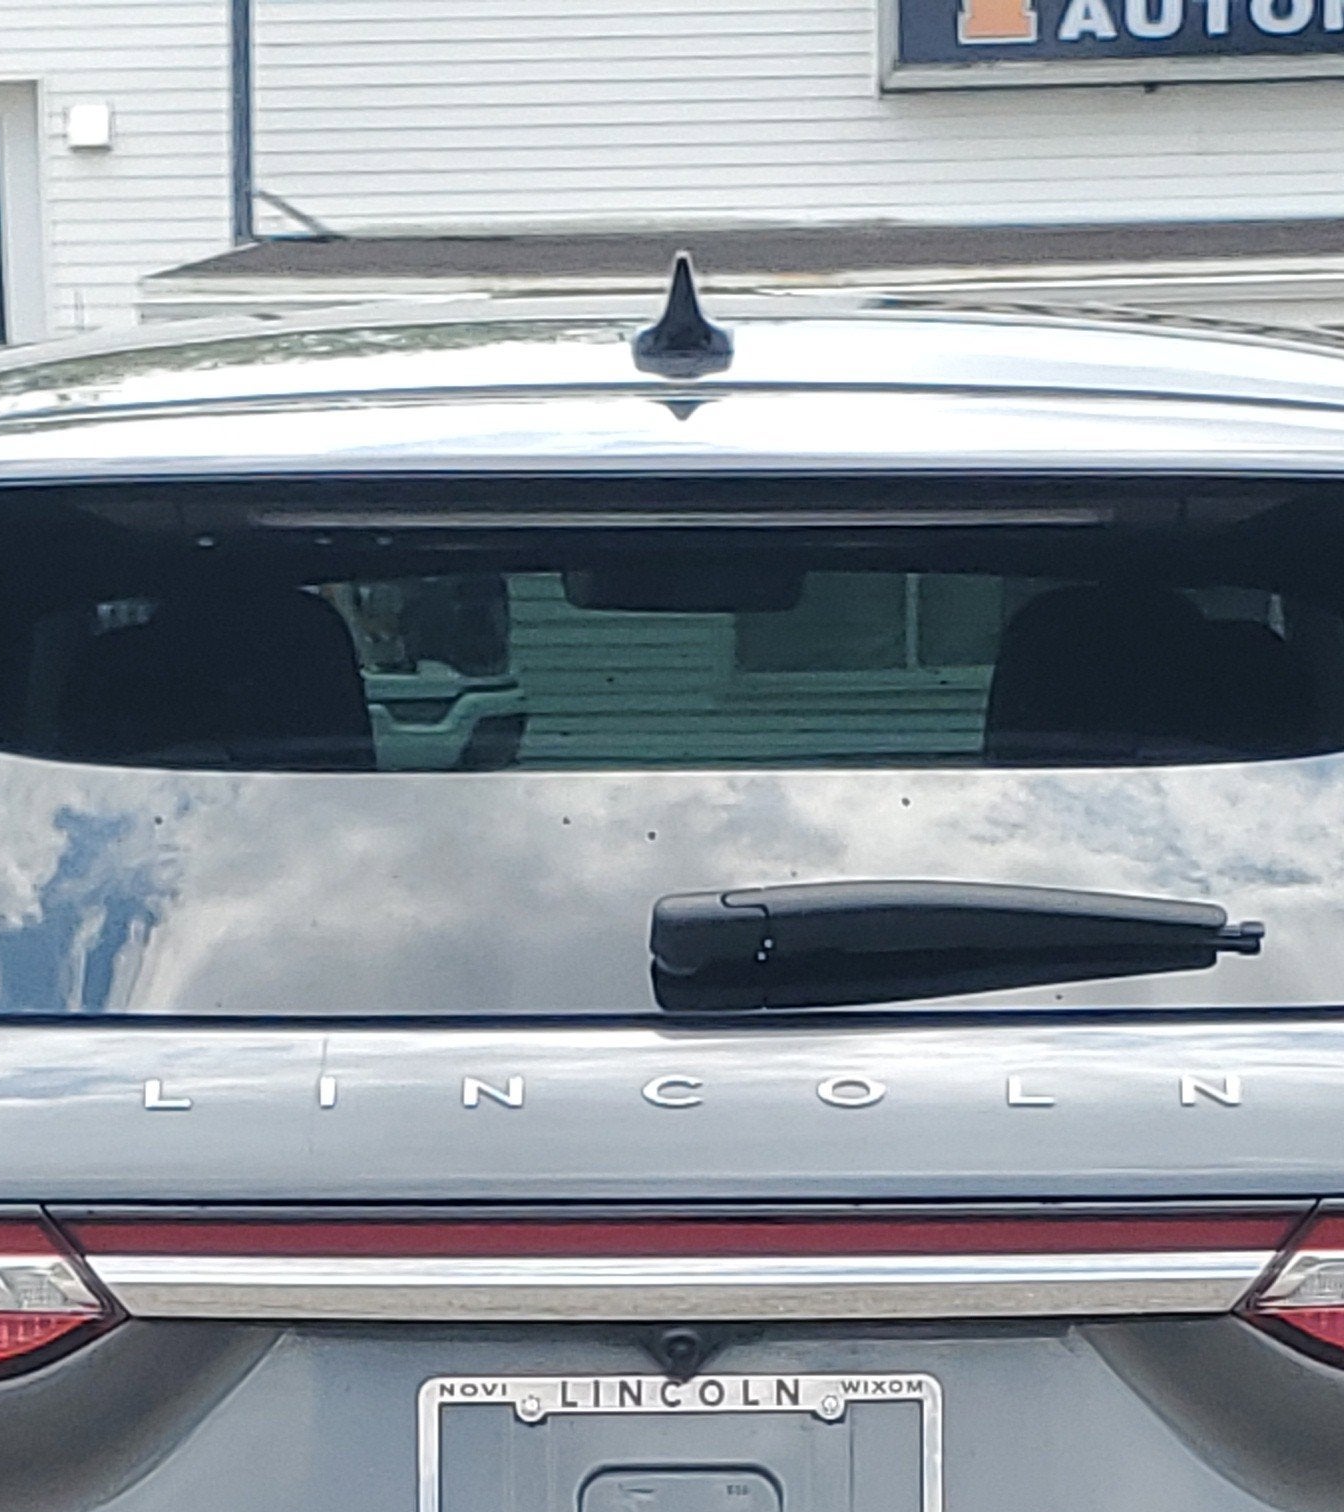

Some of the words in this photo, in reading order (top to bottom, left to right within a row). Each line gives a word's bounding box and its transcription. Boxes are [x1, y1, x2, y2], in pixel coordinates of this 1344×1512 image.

[143, 1074, 1242, 1109] LINCOLN
[439, 1383, 507, 1397] NOVI
[561, 1379, 801, 1408] LINCOLN
[841, 1379, 924, 1394] WIXOM
